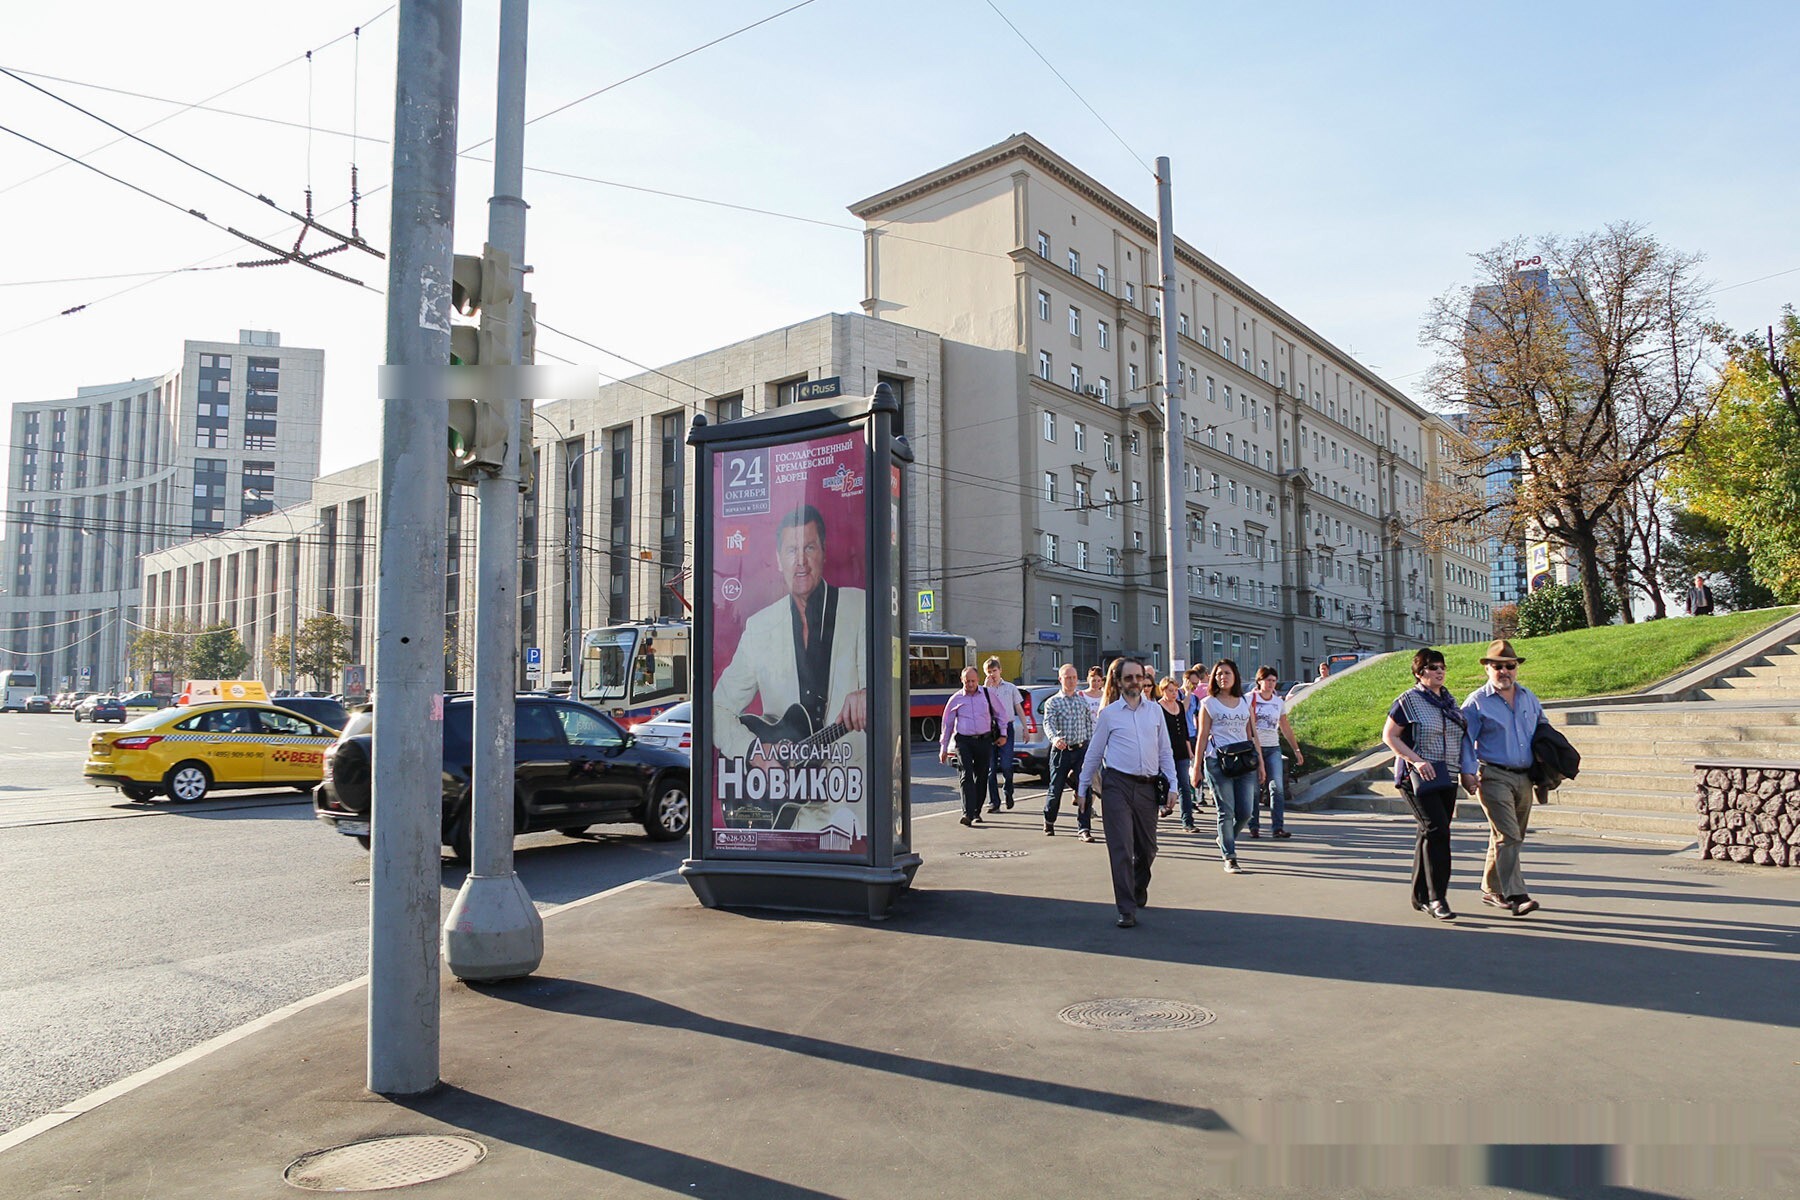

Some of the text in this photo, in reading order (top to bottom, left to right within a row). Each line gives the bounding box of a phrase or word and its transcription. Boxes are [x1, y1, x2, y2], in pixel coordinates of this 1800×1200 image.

[811, 383, 836, 395] Russ
[775, 438, 853, 463] ГОСУДАРСТВЕННЫЙ
[729, 455, 764, 487] 24
[775, 453, 834, 473] КРЕМЛЕВСКИЙ
[775, 471, 808, 484] ДВОРЕЦ
[725, 487, 766, 501] ОКТЯБРЯ
[724, 584, 741, 595] 12+
[750, 737, 853, 766] Александр
